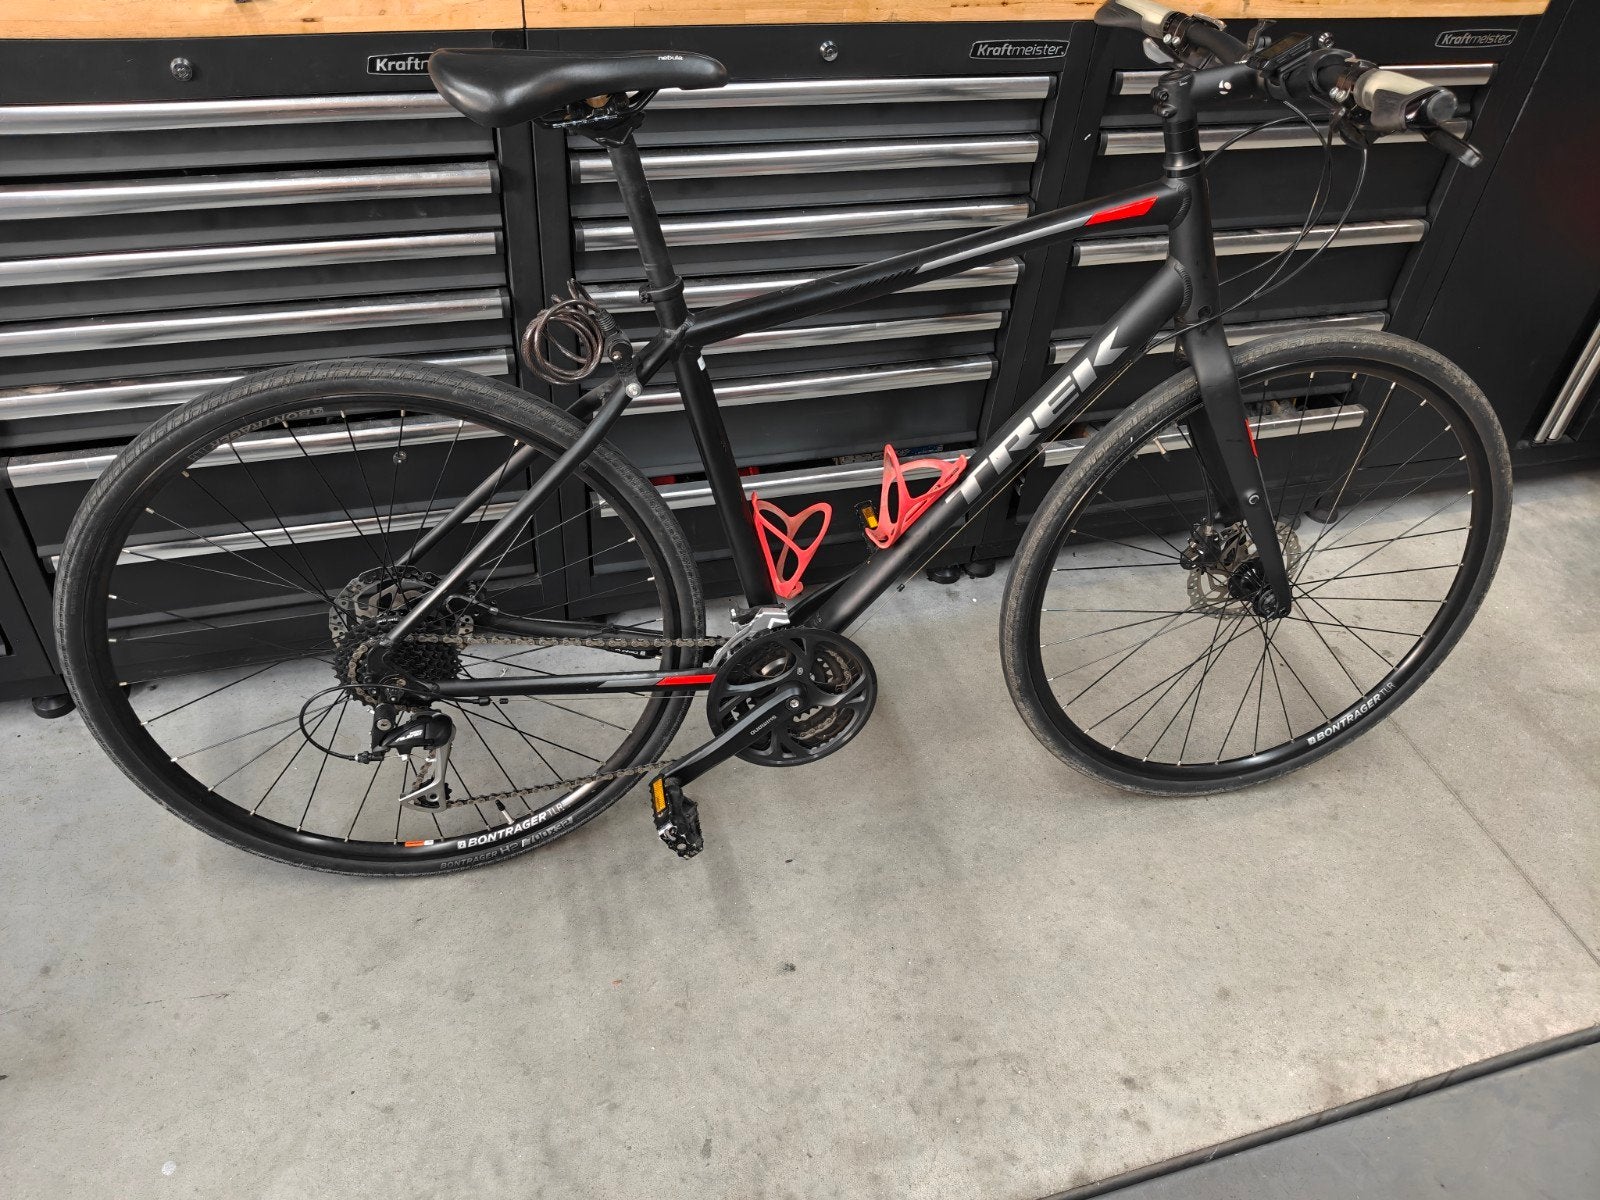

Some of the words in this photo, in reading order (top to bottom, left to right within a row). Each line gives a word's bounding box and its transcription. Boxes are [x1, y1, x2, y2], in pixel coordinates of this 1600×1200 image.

[945, 326, 1129, 504] TREK
[1316, 693, 1381, 741] BONTRAGER
[1379, 682, 1396, 696] TLR
[467, 812, 547, 848] BONTRAGER
[440, 850, 498, 870] BONTRAGER
